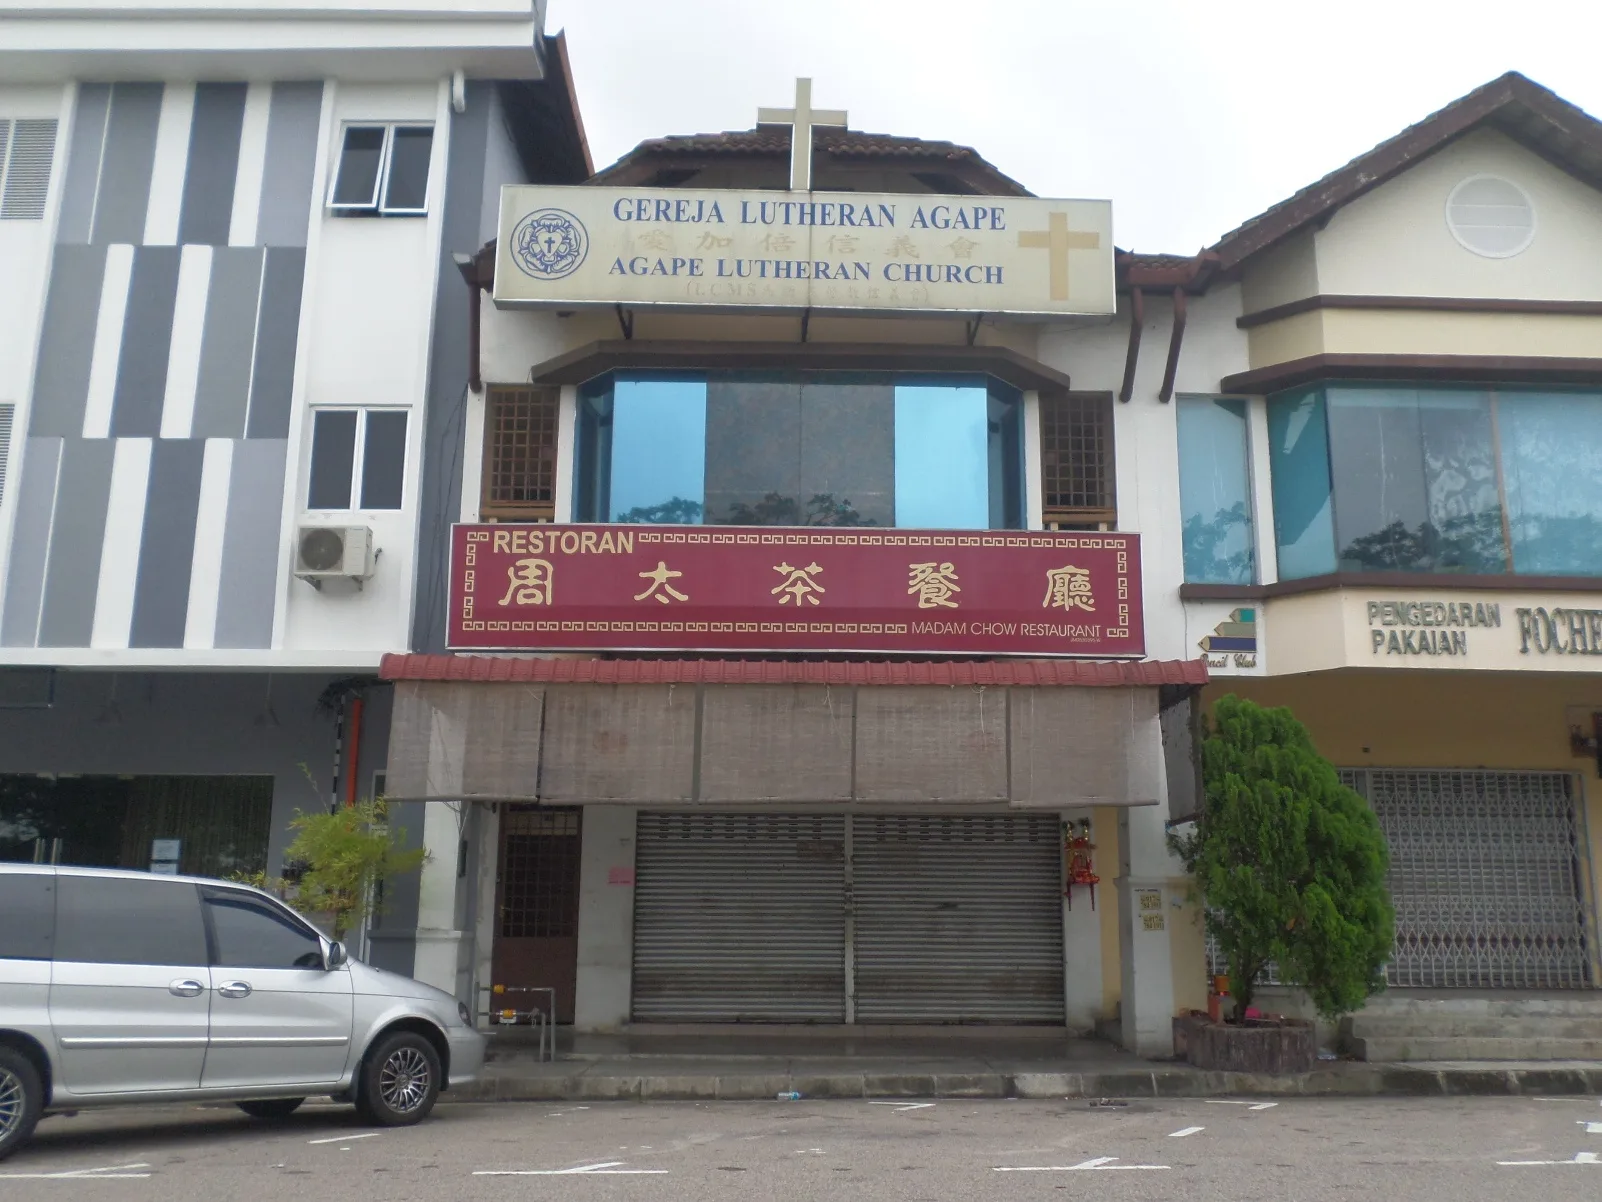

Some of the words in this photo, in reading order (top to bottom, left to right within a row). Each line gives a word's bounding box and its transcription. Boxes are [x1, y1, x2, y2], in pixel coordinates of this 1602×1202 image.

[613, 198, 725, 225] GEREJA
[740, 200, 896, 228] LUTHERAN
[910, 205, 1006, 231] AGAPE
[608, 255, 705, 278] AGAPE
[716, 257, 871, 281] LUTHERAN
[882, 262, 1005, 285] CHURCH
[493, 530, 634, 555] RESTORAN
[498, 557, 1098, 613] 周太茶餐廳
[1366, 600, 1502, 628] PENGEDARAN
[911, 621, 967, 635] MADAM
[970, 622, 1017, 636] CHOW
[1020, 623, 1101, 638] RESTAURANT
[1371, 629, 1468, 656] PAKAIAN
[1200, 653, 1228, 668] Pncil
